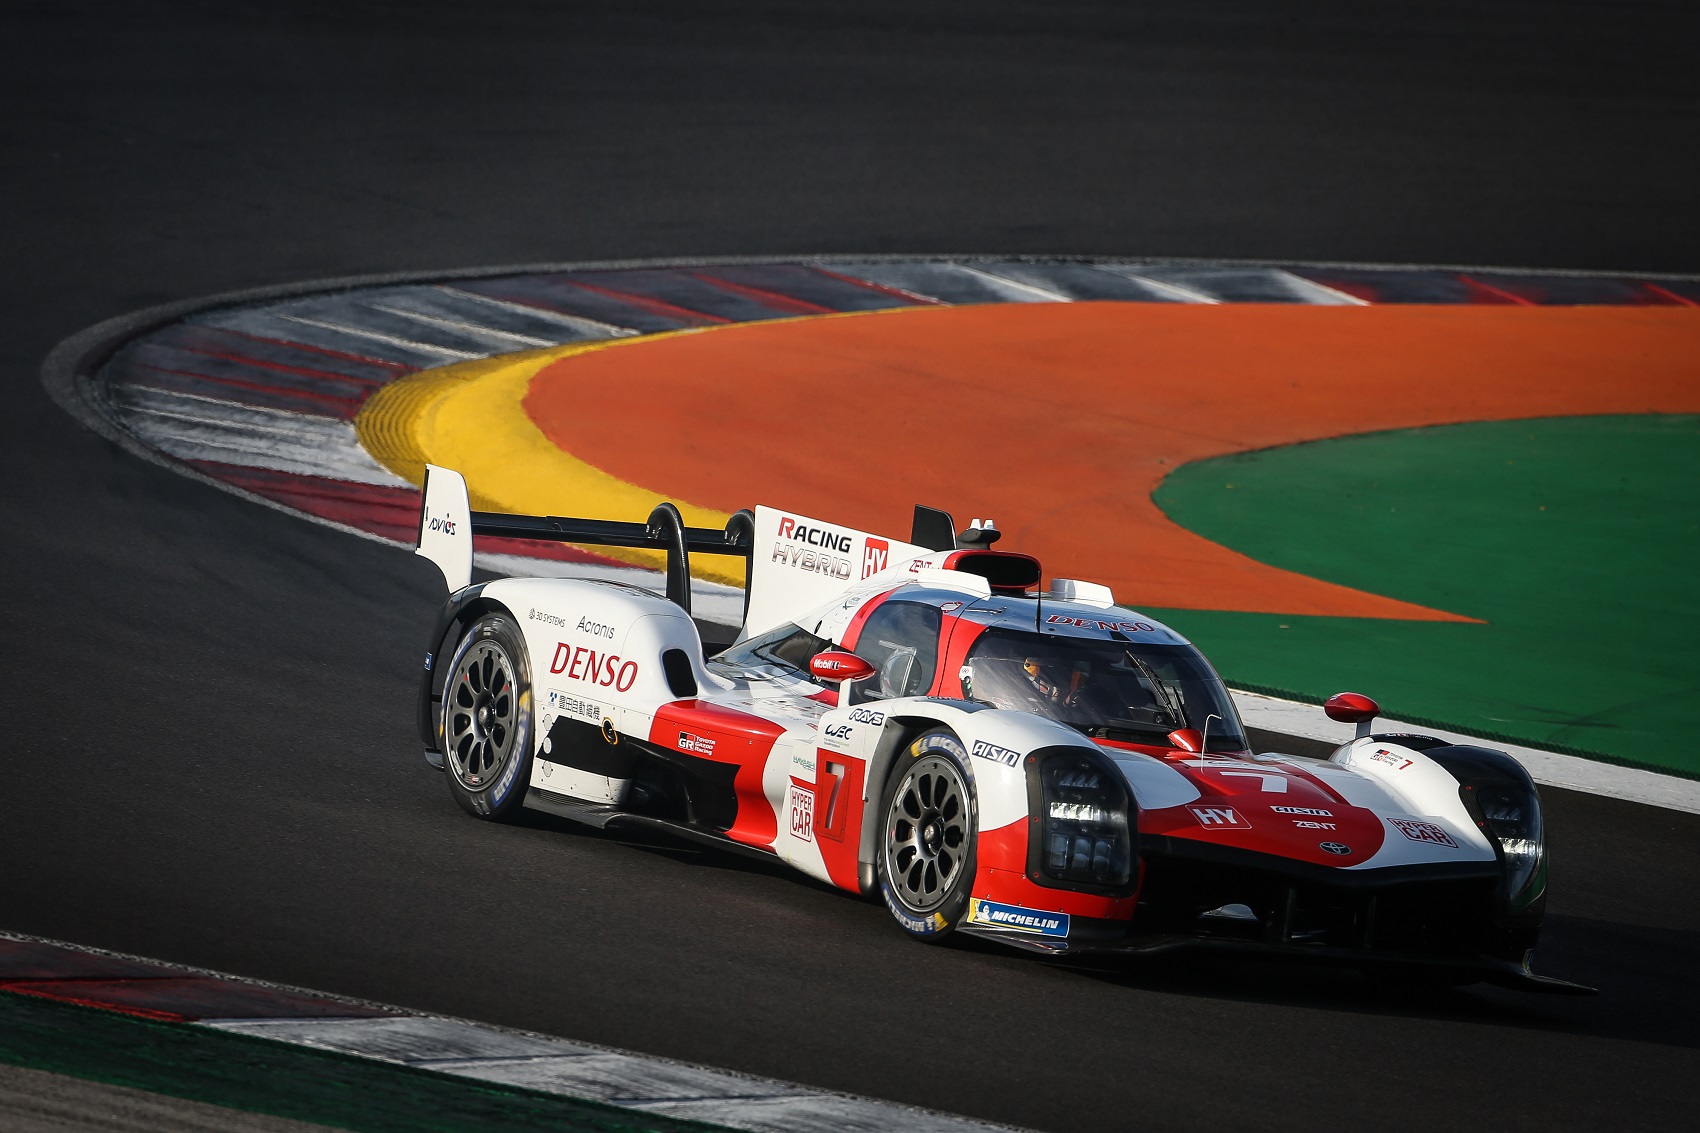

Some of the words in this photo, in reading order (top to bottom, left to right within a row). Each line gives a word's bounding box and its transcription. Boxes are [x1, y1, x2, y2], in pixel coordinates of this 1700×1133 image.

[777, 516, 853, 554] RACING
[771, 542, 852, 580] HYBRID
[862, 546, 888, 579] HY
[543, 613, 566, 628] SYSTEMS
[576, 615, 615, 639] Acronis
[1046, 614, 1155, 633] DENSO
[550, 642, 639, 693] DENSO
[813, 659, 832, 670] Mobil
[849, 708, 884, 726] RAYS
[825, 723, 853, 740] WEC
[679, 738, 694, 751] GR
[973, 741, 1019, 766] AISIN
[1399, 759, 1414, 770] 7
[792, 791, 812, 812] HYPER
[825, 761, 845, 829] 7
[792, 807, 811, 837] CAR
[1192, 808, 1238, 825] HY
[1292, 820, 1336, 830] ZENT
[1392, 820, 1442, 833] HYPER
[1402, 827, 1454, 845] CAR
[991, 910, 1060, 930] MICHELIN
